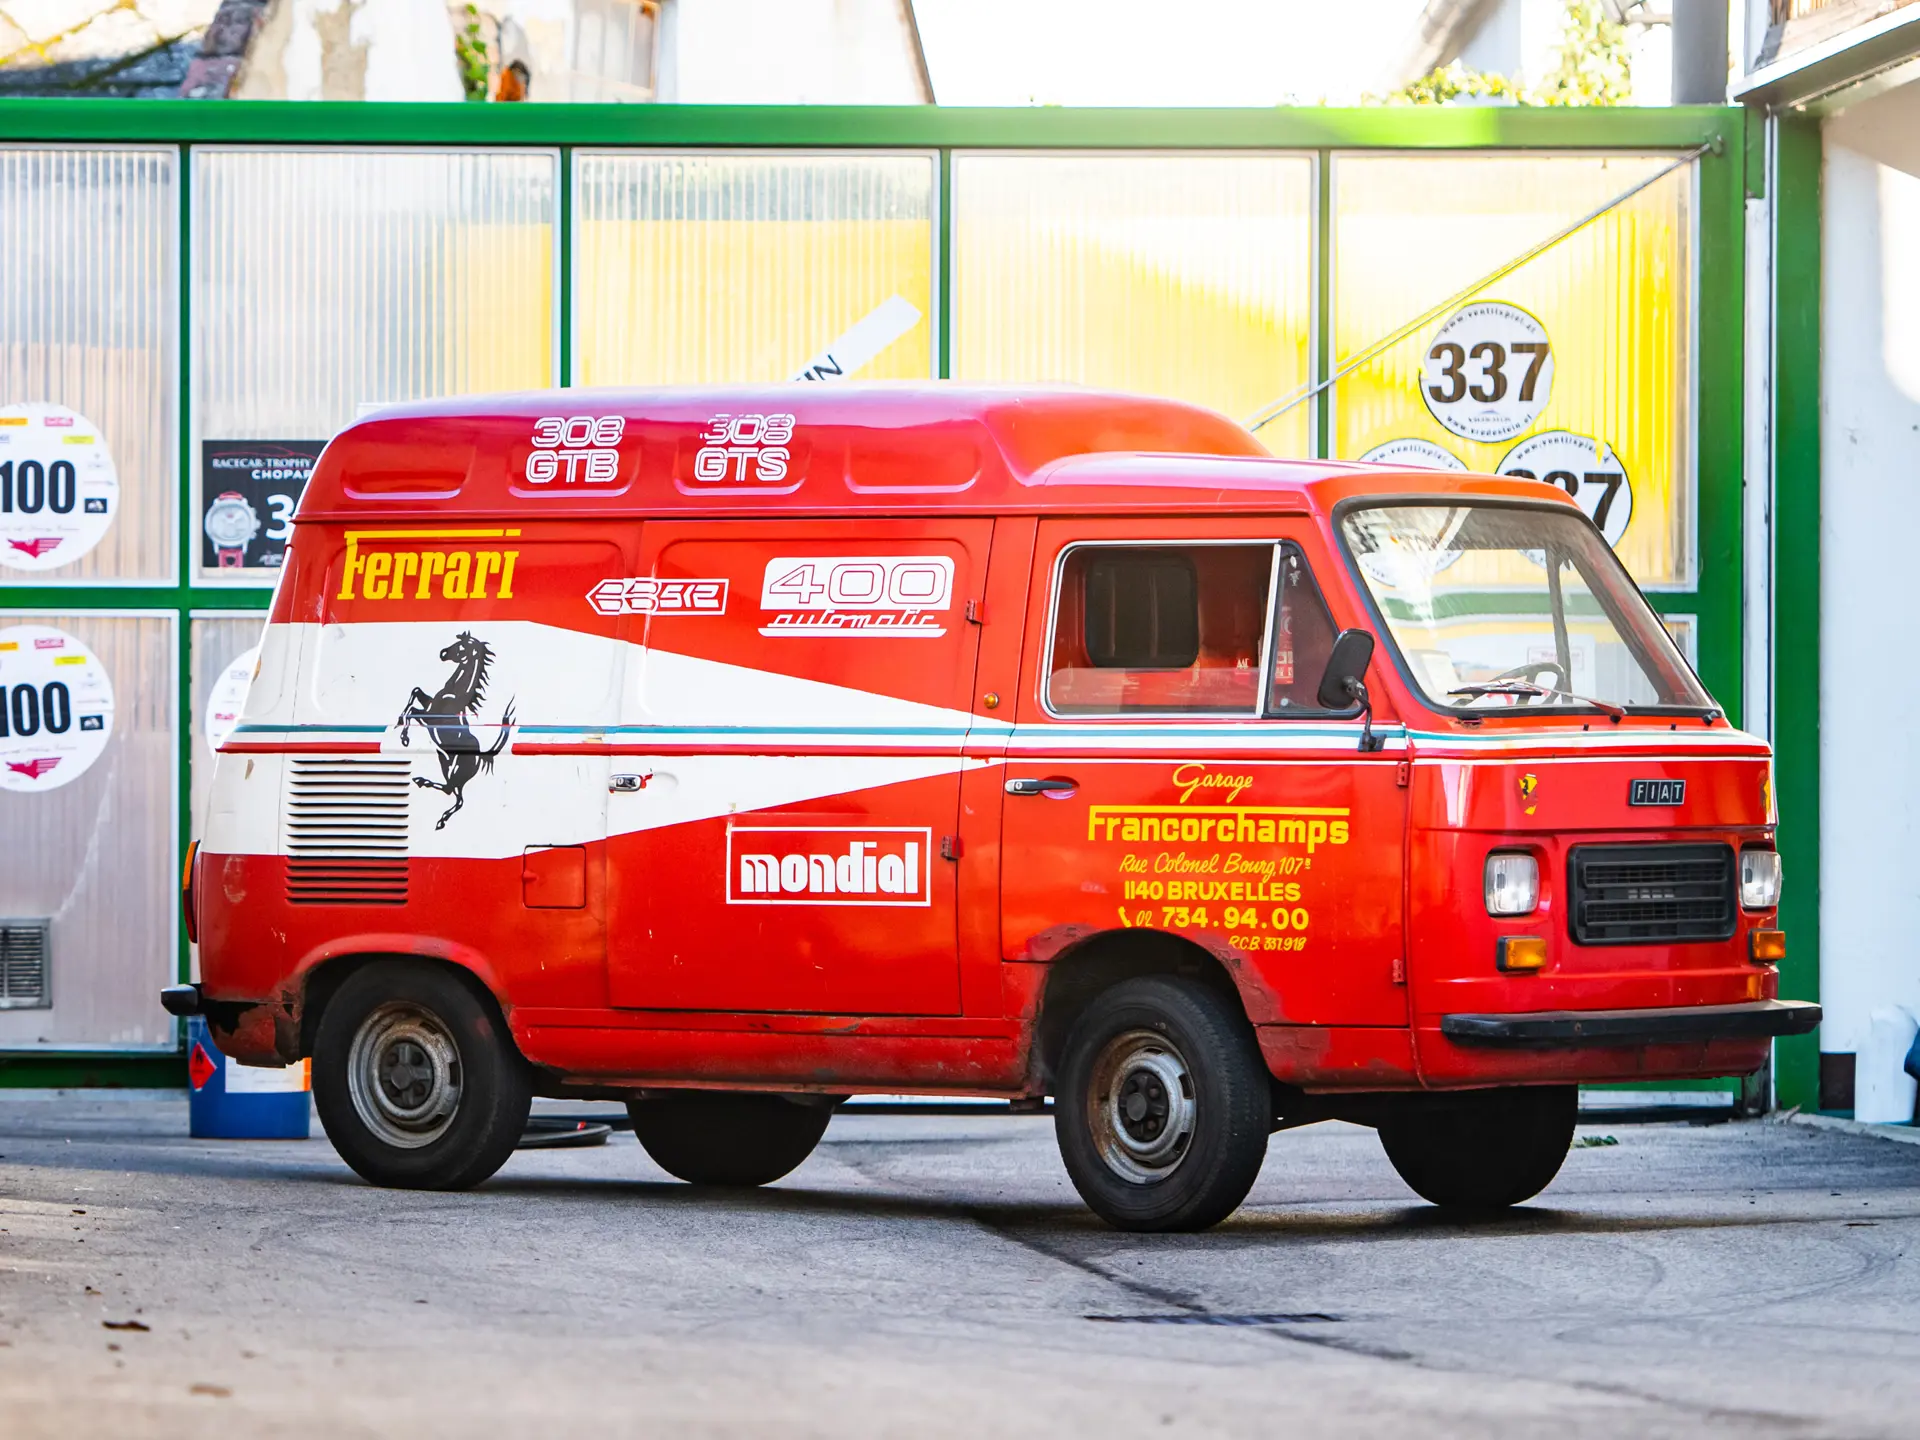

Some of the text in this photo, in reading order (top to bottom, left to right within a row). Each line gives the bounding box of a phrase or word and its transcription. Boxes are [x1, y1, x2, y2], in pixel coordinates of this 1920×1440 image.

[1428, 342, 1549, 403] 337
[531, 415, 626, 448] 308
[700, 413, 796, 445] 308
[525, 448, 619, 483] GTB
[694, 446, 790, 481] GTS
[0, 459, 76, 514] 100
[337, 529, 522, 600] Ferrari
[768, 562, 947, 605] 400
[769, 608, 939, 629] automatic
[0, 681, 71, 737] 100
[1172, 763, 1254, 804] Garage
[1635, 782, 1685, 802] FIAT
[1087, 804, 1350, 854] Francorchamps
[741, 841, 919, 894] mondial
[1118, 853, 1148, 874] Rue
[1153, 851, 1220, 874] Colonel
[1124, 880, 1302, 902] 1140 BRUXELLES
[1135, 910, 1153, 928] 02
